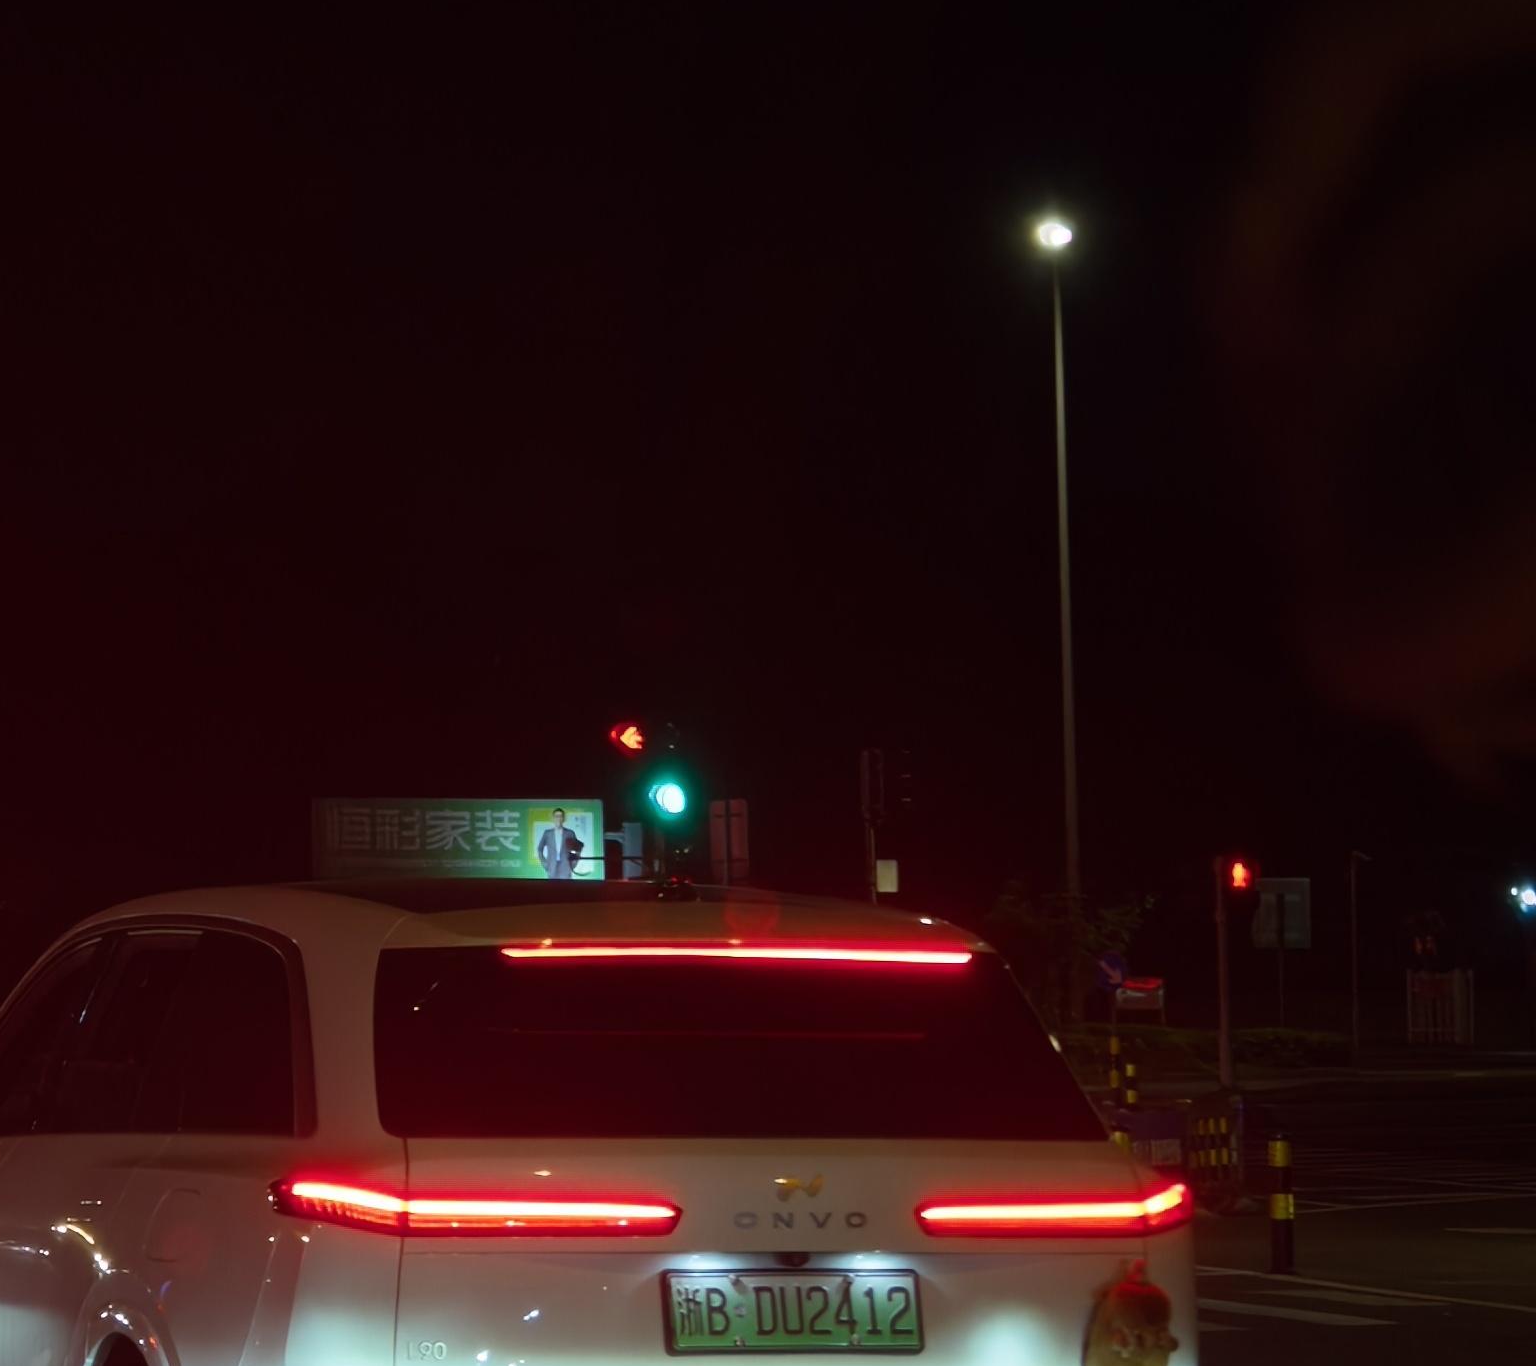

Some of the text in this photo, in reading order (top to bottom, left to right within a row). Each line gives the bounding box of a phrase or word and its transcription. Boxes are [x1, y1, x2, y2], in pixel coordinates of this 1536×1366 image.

[733, 1211, 867, 1229] ONVO
[676, 1285, 914, 1336] 浙B DU2412
